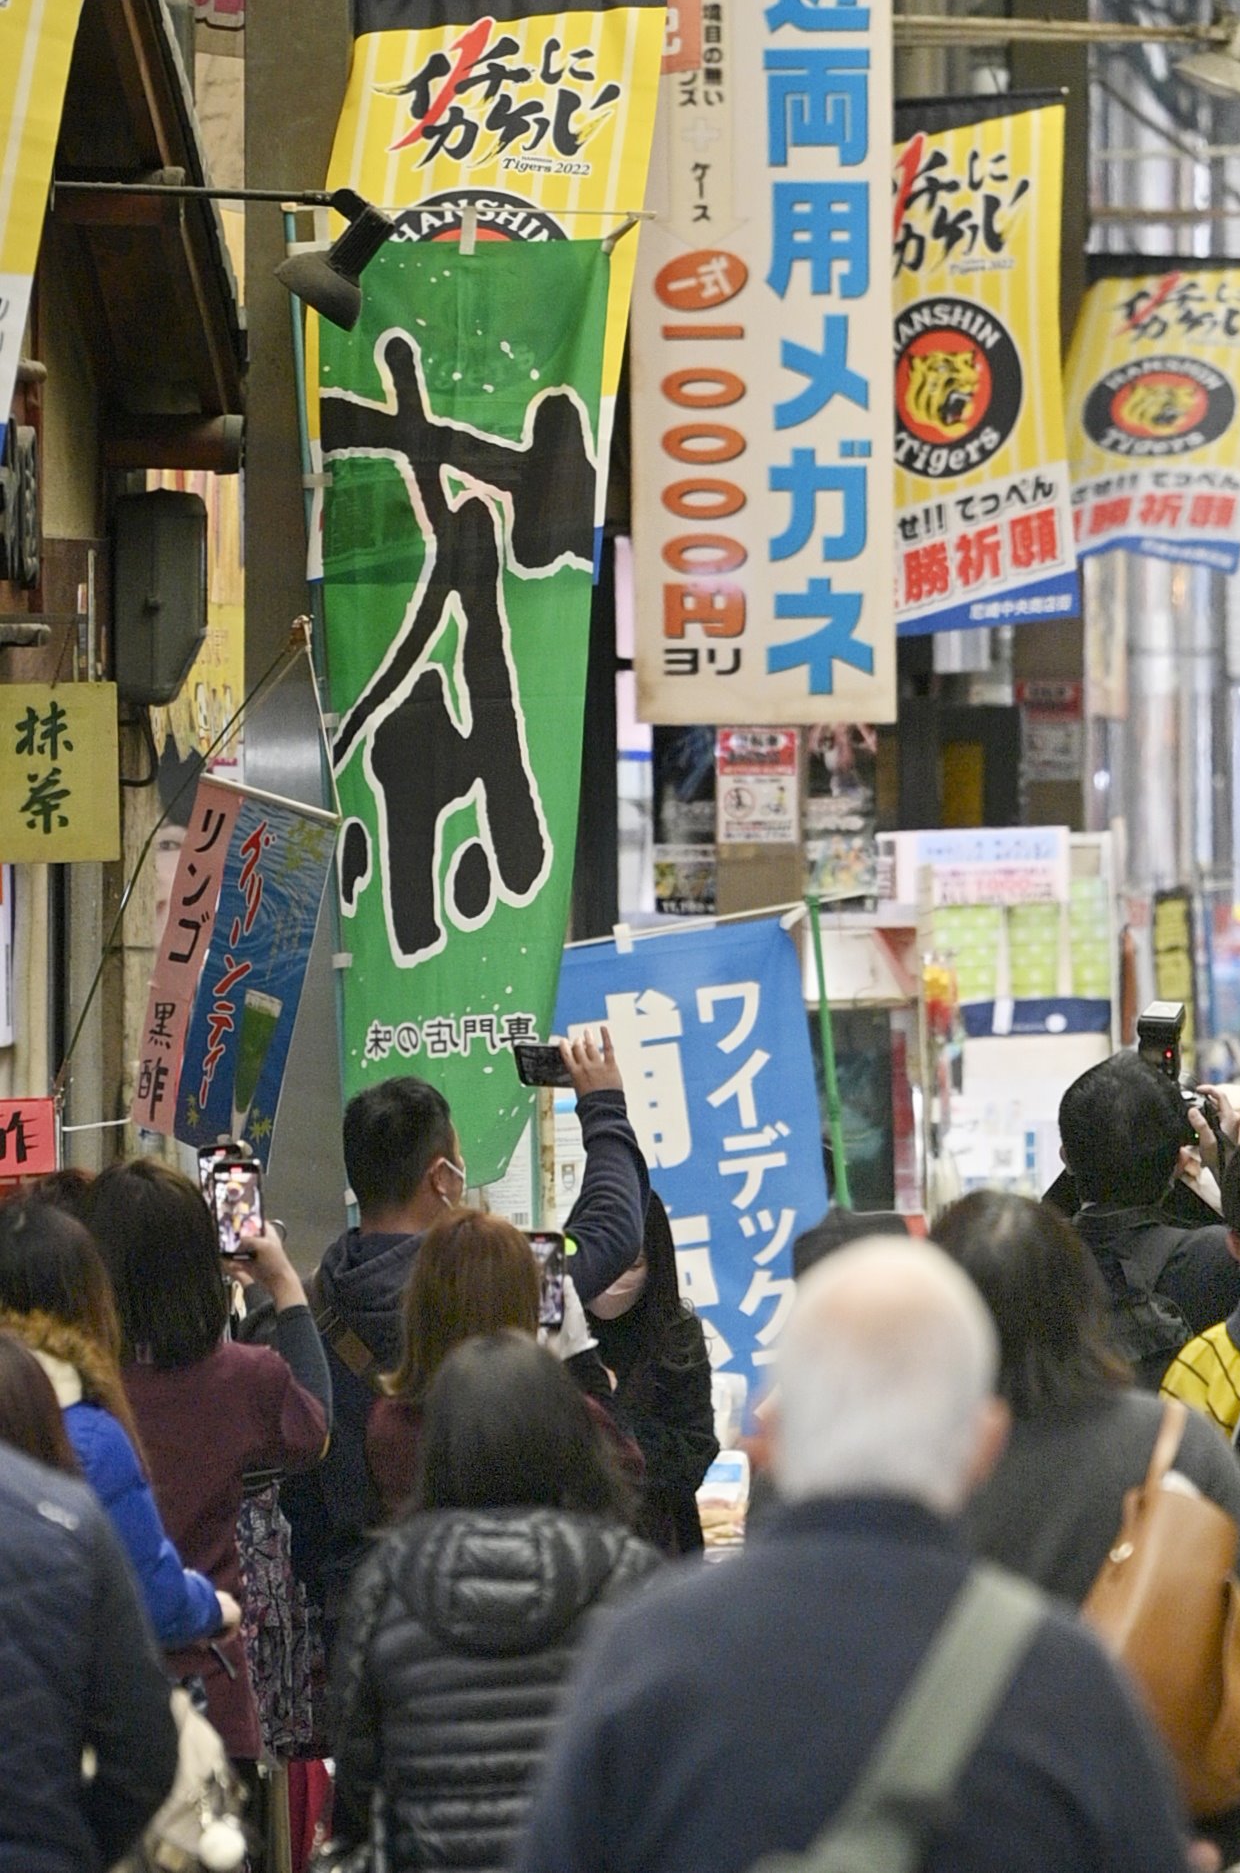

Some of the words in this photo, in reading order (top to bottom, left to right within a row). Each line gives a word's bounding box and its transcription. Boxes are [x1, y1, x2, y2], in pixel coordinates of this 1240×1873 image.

[502, 157, 552, 174] Tigers
[553, 162, 591, 176] 2022
[894, 302, 1001, 349] ANSHIN
[894, 507, 1057, 608] 勝祈願
[663, 646, 742, 677] ヨリ
[15, 700, 74, 834] 抹茶
[696, 982, 796, 1417] ワイデック
